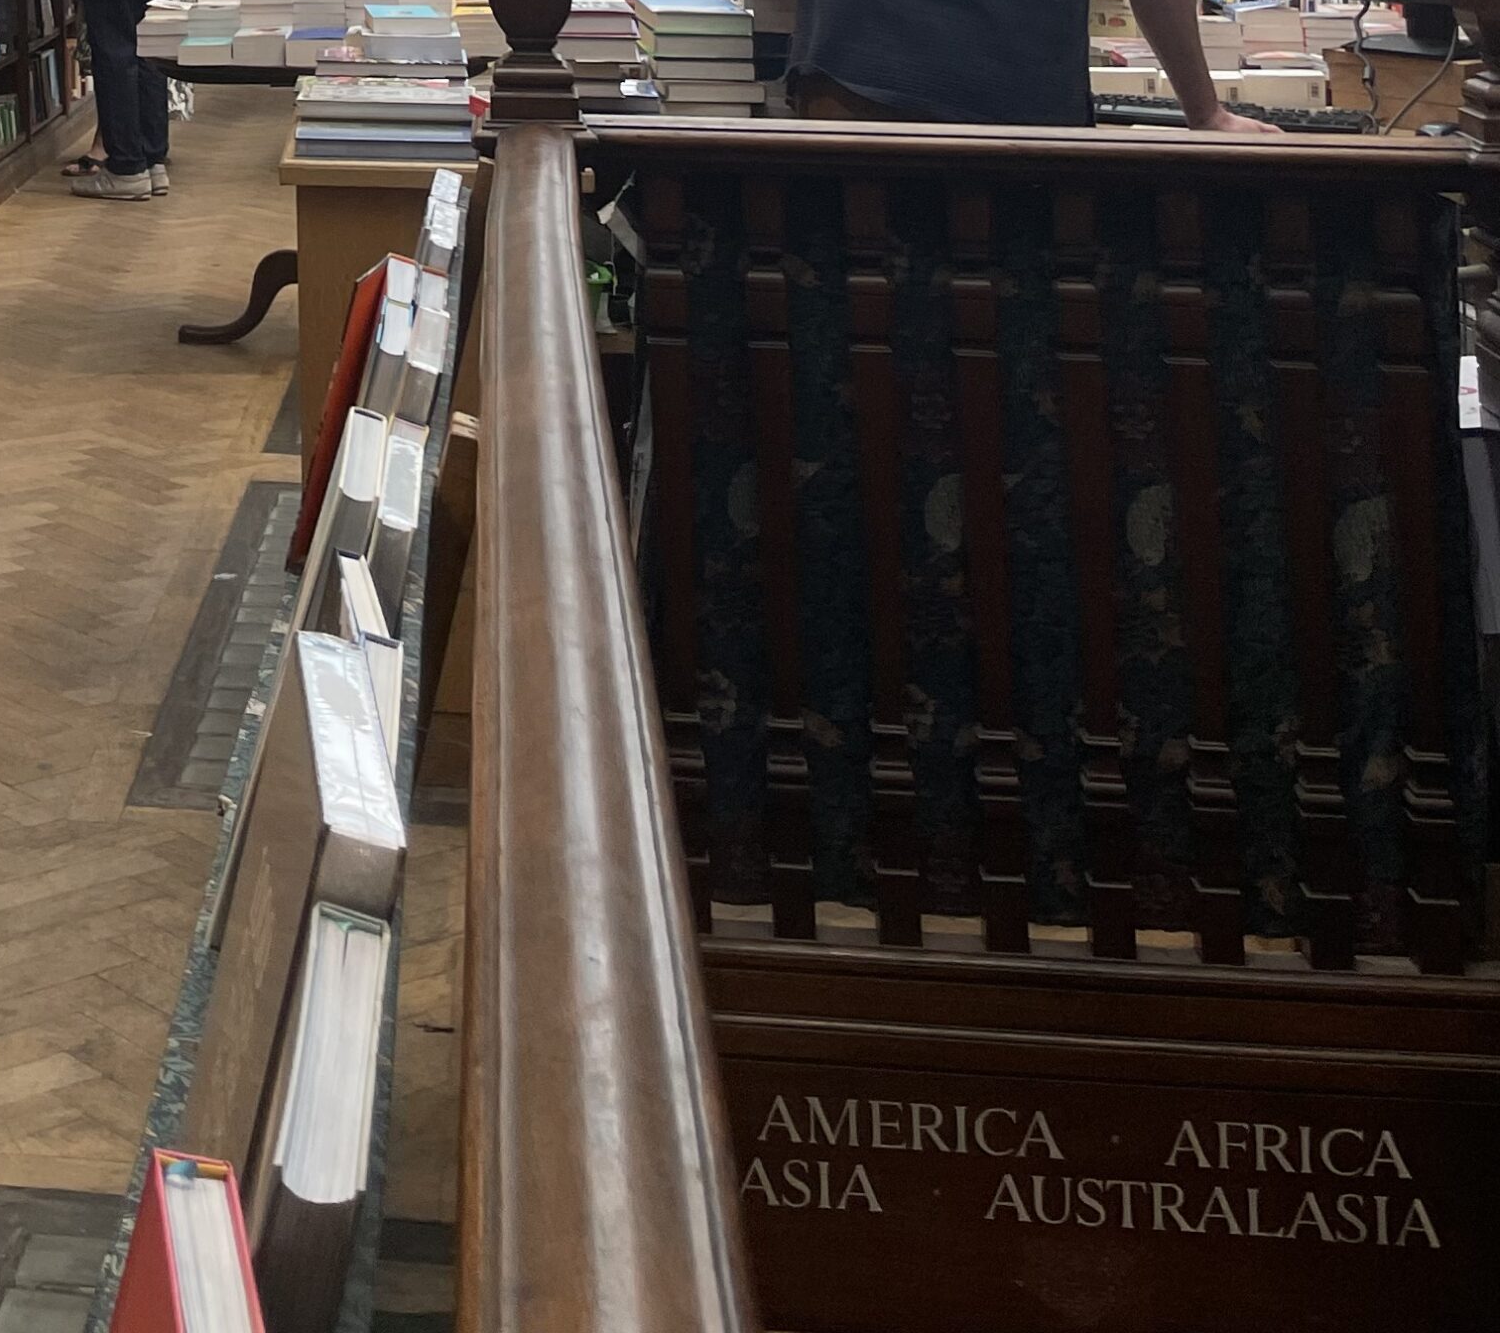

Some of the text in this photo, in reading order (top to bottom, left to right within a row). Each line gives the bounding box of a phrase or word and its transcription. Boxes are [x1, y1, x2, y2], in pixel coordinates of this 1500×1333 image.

[757, 1094, 1413, 1179] AMERICA AFRICA
[740, 1155, 1441, 1249] ASIA AUSTRALASIA
